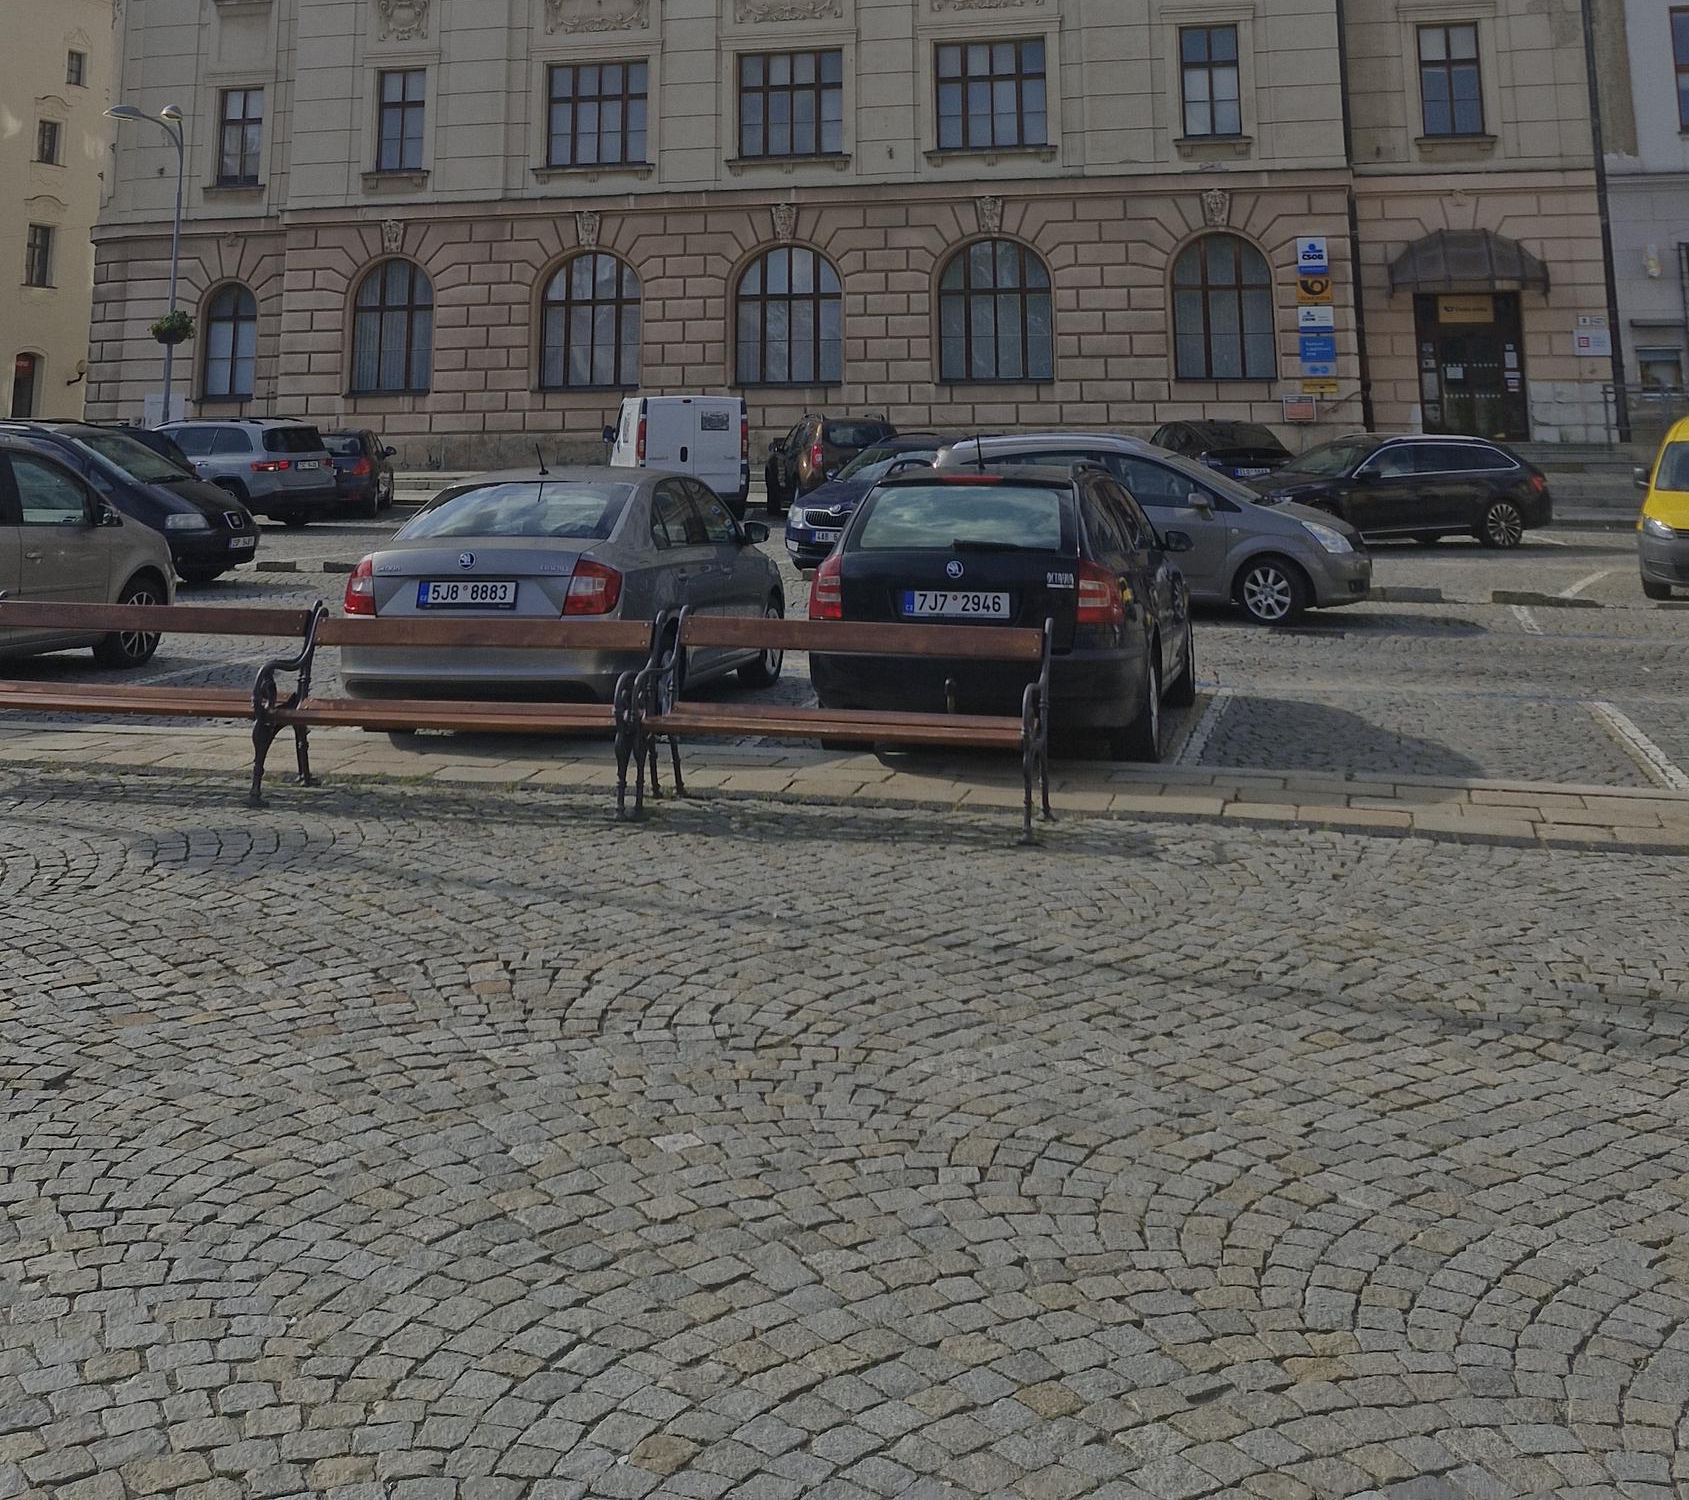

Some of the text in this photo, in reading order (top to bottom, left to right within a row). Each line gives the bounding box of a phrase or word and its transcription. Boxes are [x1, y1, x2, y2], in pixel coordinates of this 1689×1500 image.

[432, 585, 459, 601] 5J8
[470, 585, 507, 601] 8883
[919, 593, 948, 611] 7J7
[961, 594, 1001, 612] 2946
